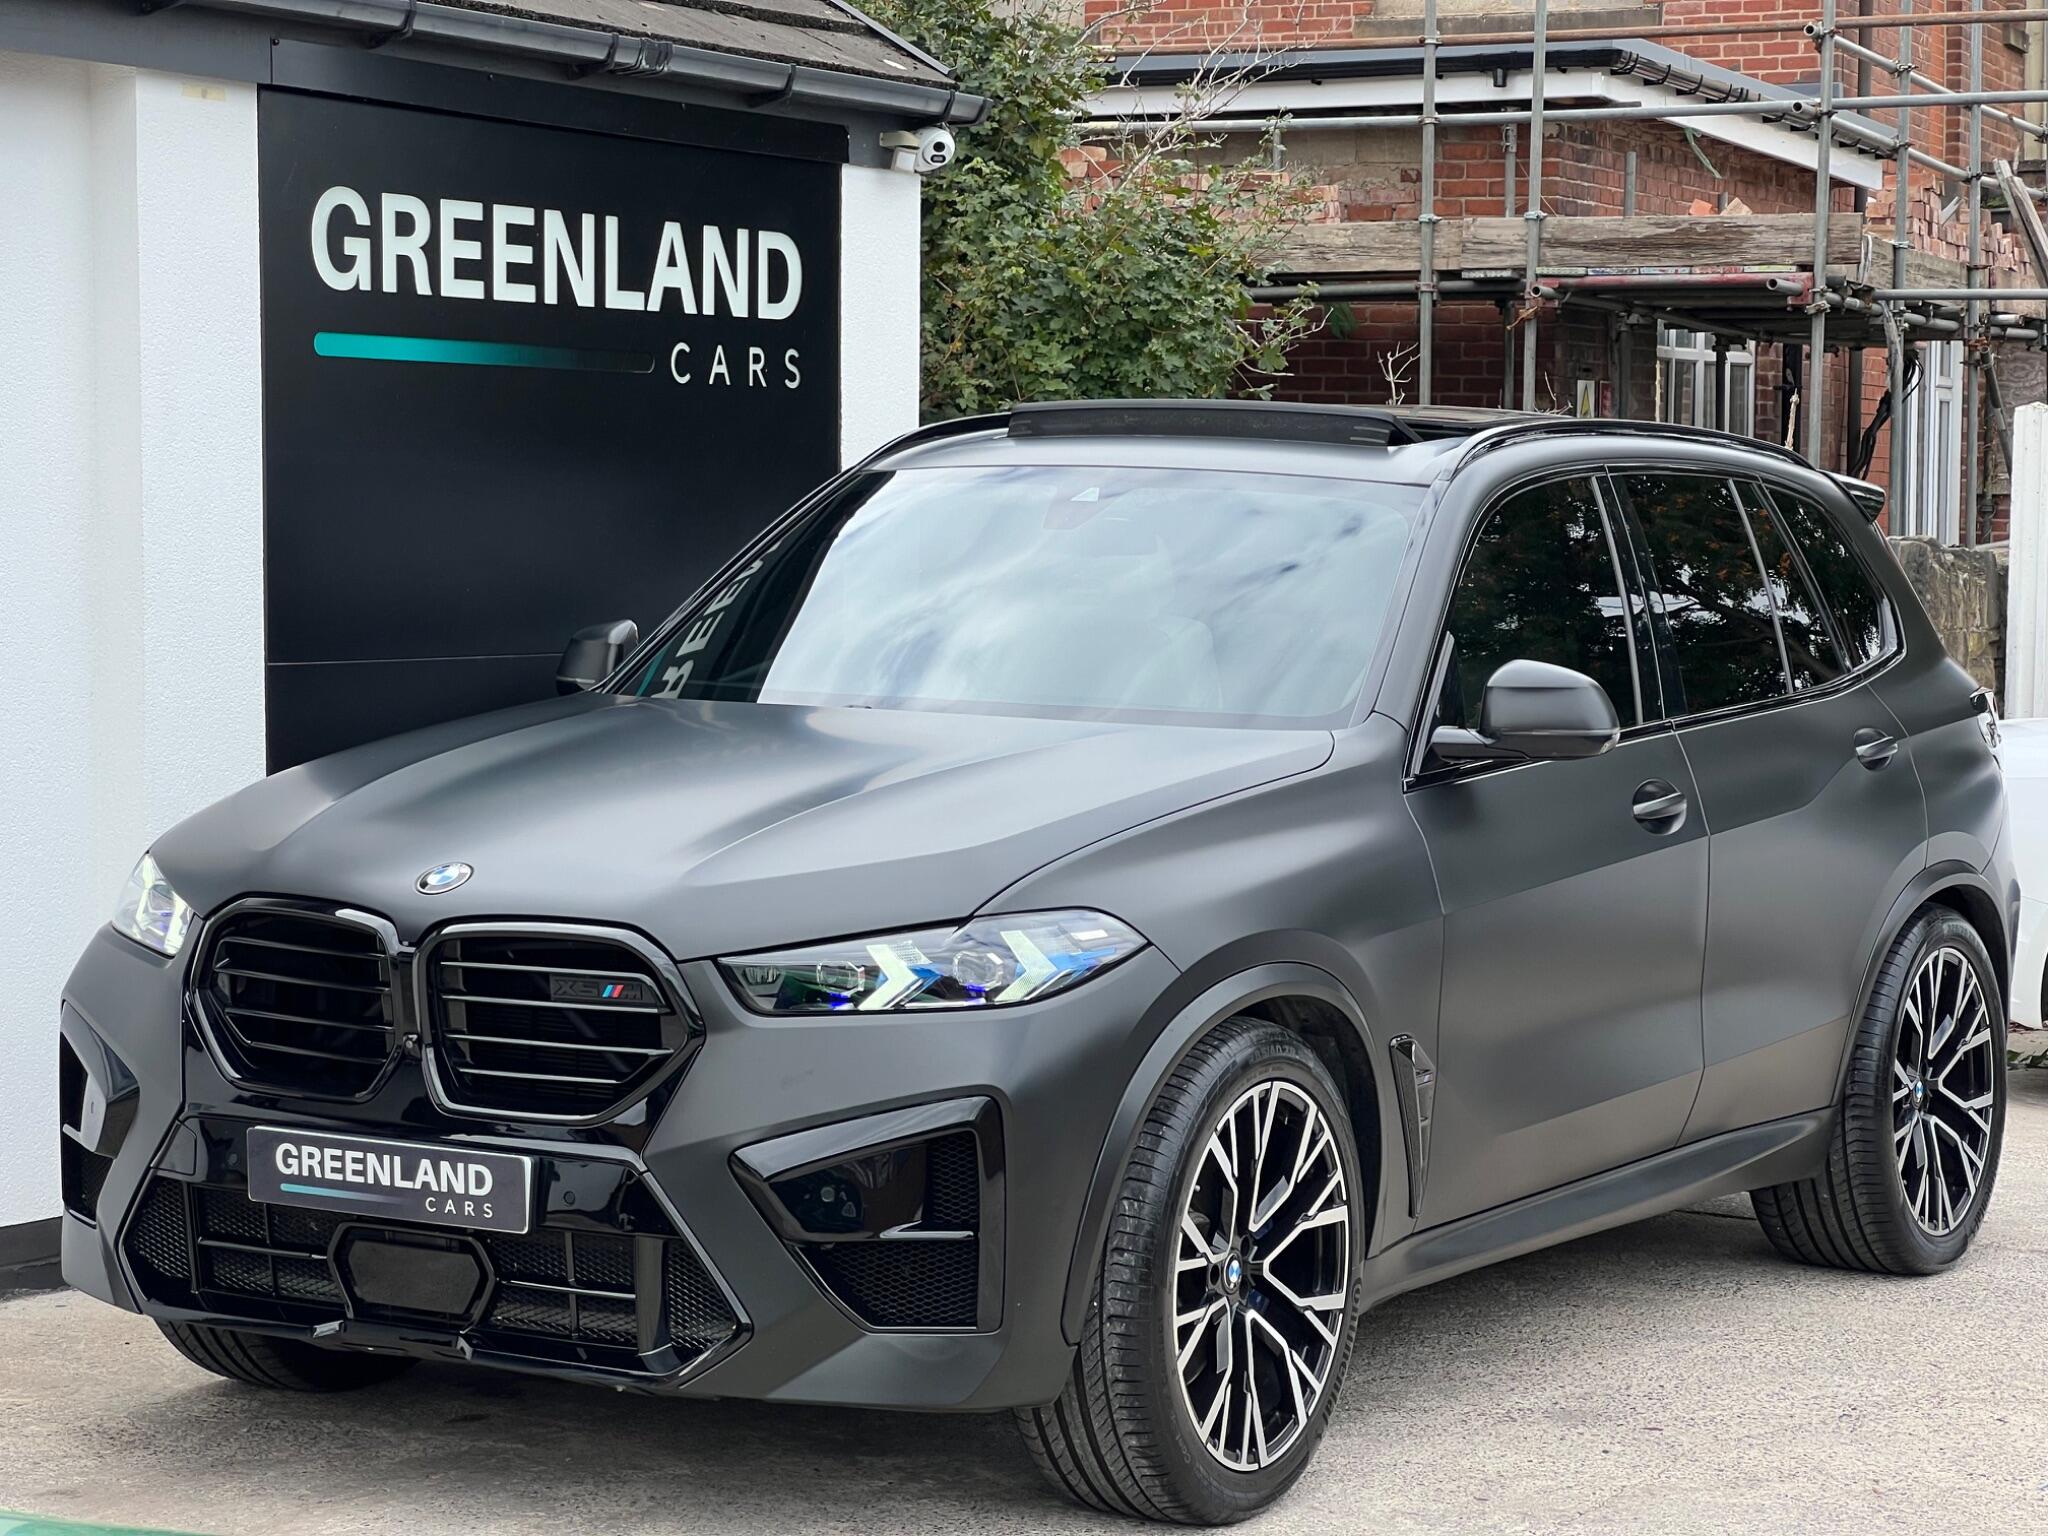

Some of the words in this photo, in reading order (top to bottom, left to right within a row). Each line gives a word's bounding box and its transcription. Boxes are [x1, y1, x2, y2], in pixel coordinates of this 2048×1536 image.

[311, 186, 802, 320] GREENLAND
[671, 342, 801, 389] CARS
[275, 1143, 493, 1196] GREENLAND
[426, 1197, 493, 1218] CARS
